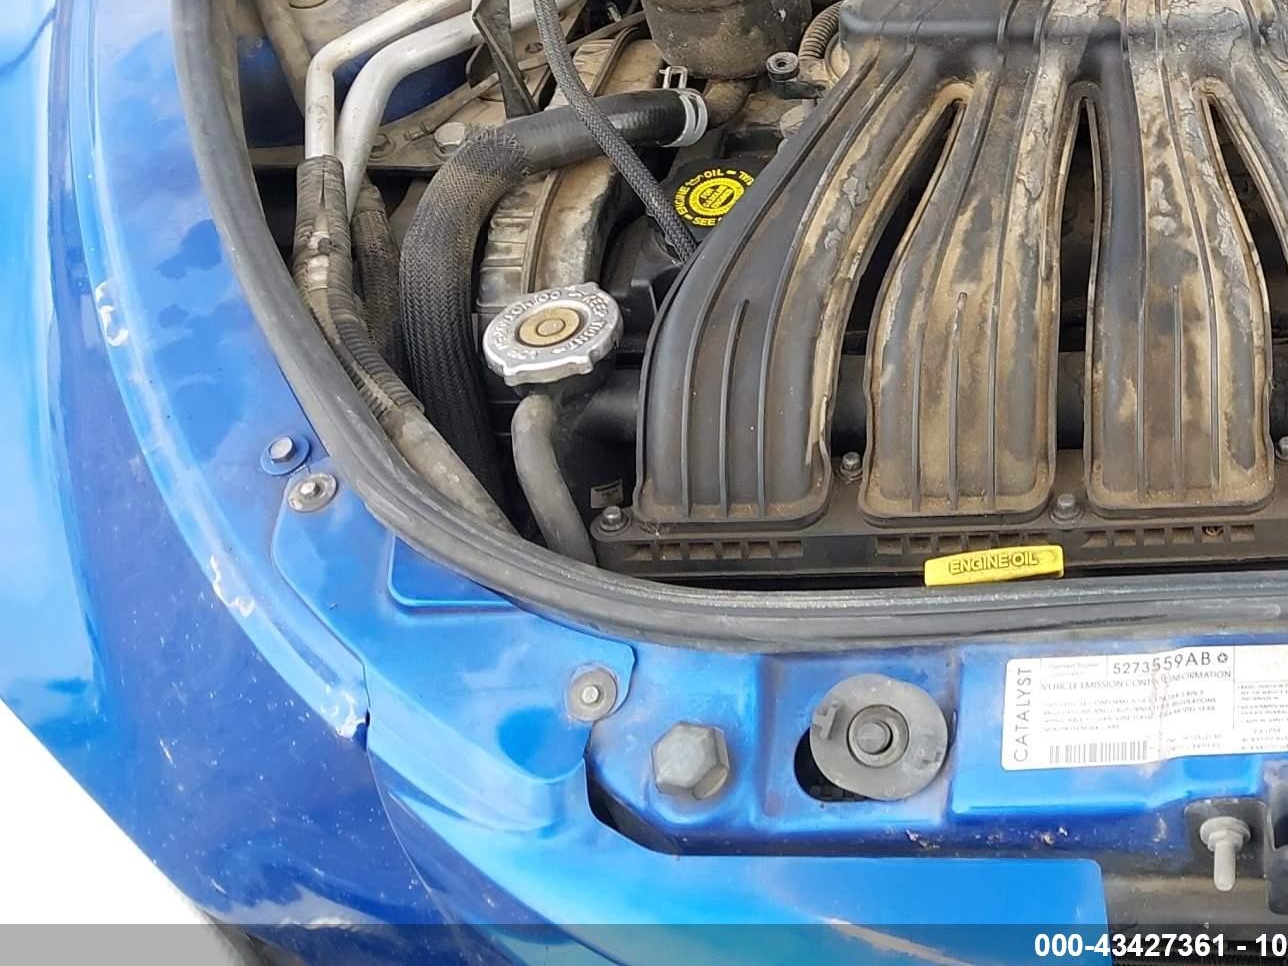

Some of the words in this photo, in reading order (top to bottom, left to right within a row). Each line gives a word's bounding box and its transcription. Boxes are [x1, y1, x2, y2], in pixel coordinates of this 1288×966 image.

[703, 168, 725, 179] OIL
[692, 217, 717, 226] SEE
[949, 553, 1009, 575] ENGINE
[1010, 551, 1038, 567] OIL
[1113, 651, 1211, 675] 5273559AB
[1042, 681, 1077, 691] VEHICLE
[1080, 679, 1123, 690] EMISSION
[1169, 669, 1231, 682] INFORMATION
[1013, 667, 1032, 763] CATALYST
